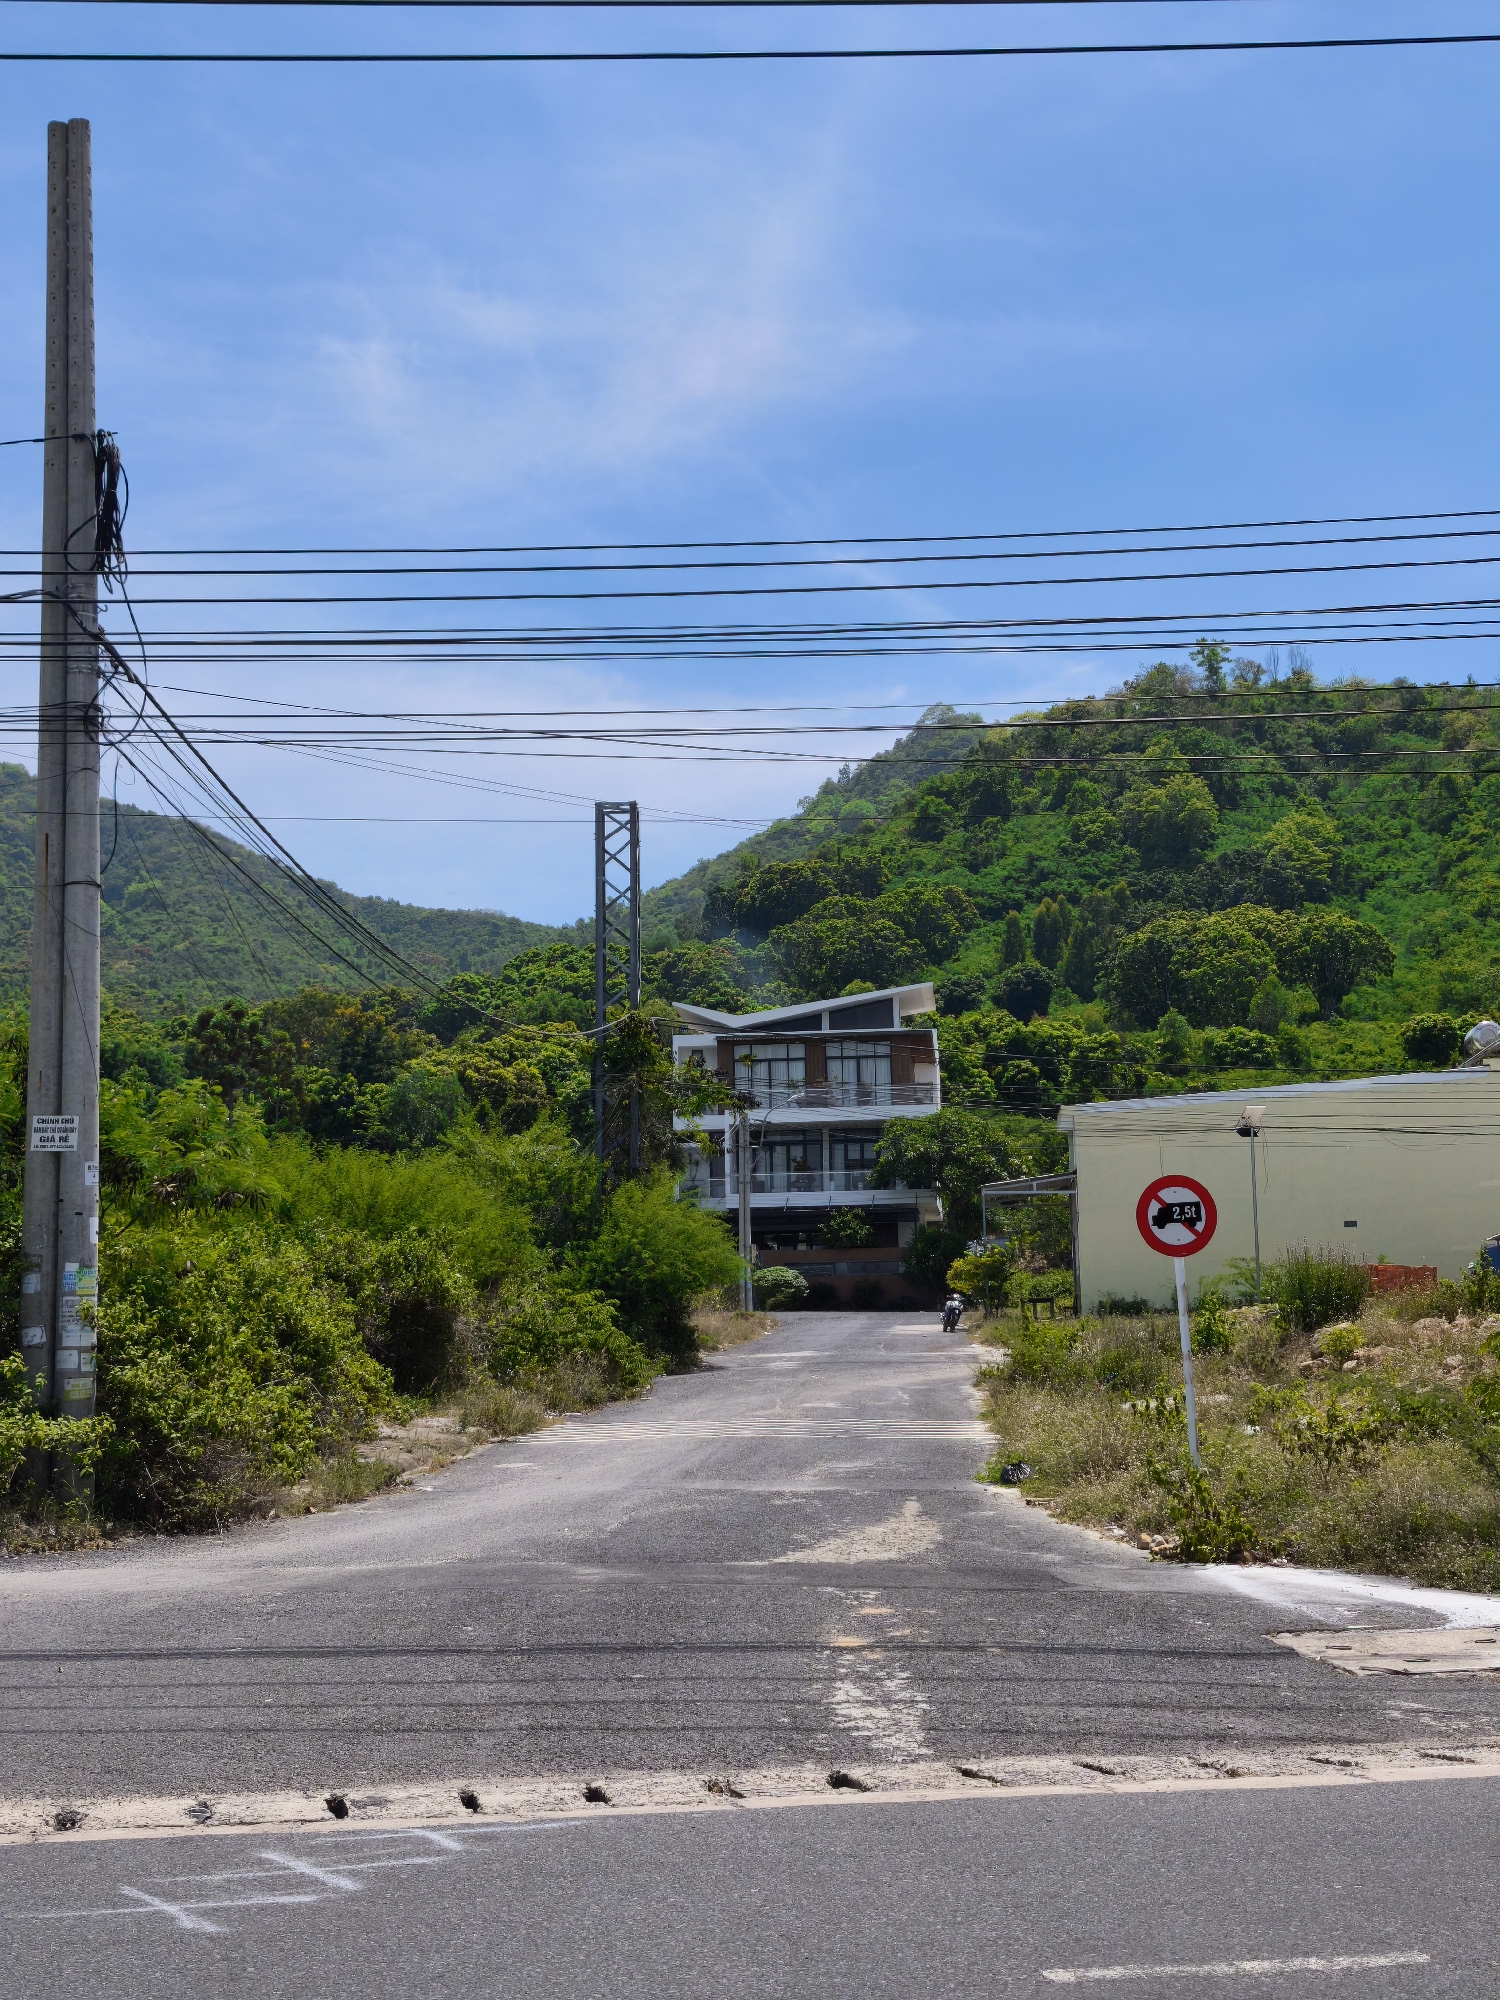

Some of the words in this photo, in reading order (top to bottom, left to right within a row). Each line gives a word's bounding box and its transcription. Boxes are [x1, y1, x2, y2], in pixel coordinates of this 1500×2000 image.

[61, 1116, 74, 1124] CHỦ
[39, 1134, 55, 1142] GIÁ
[59, 1134, 69, 1142] RẺ
[1172, 1205, 1196, 1220] 2,5t
